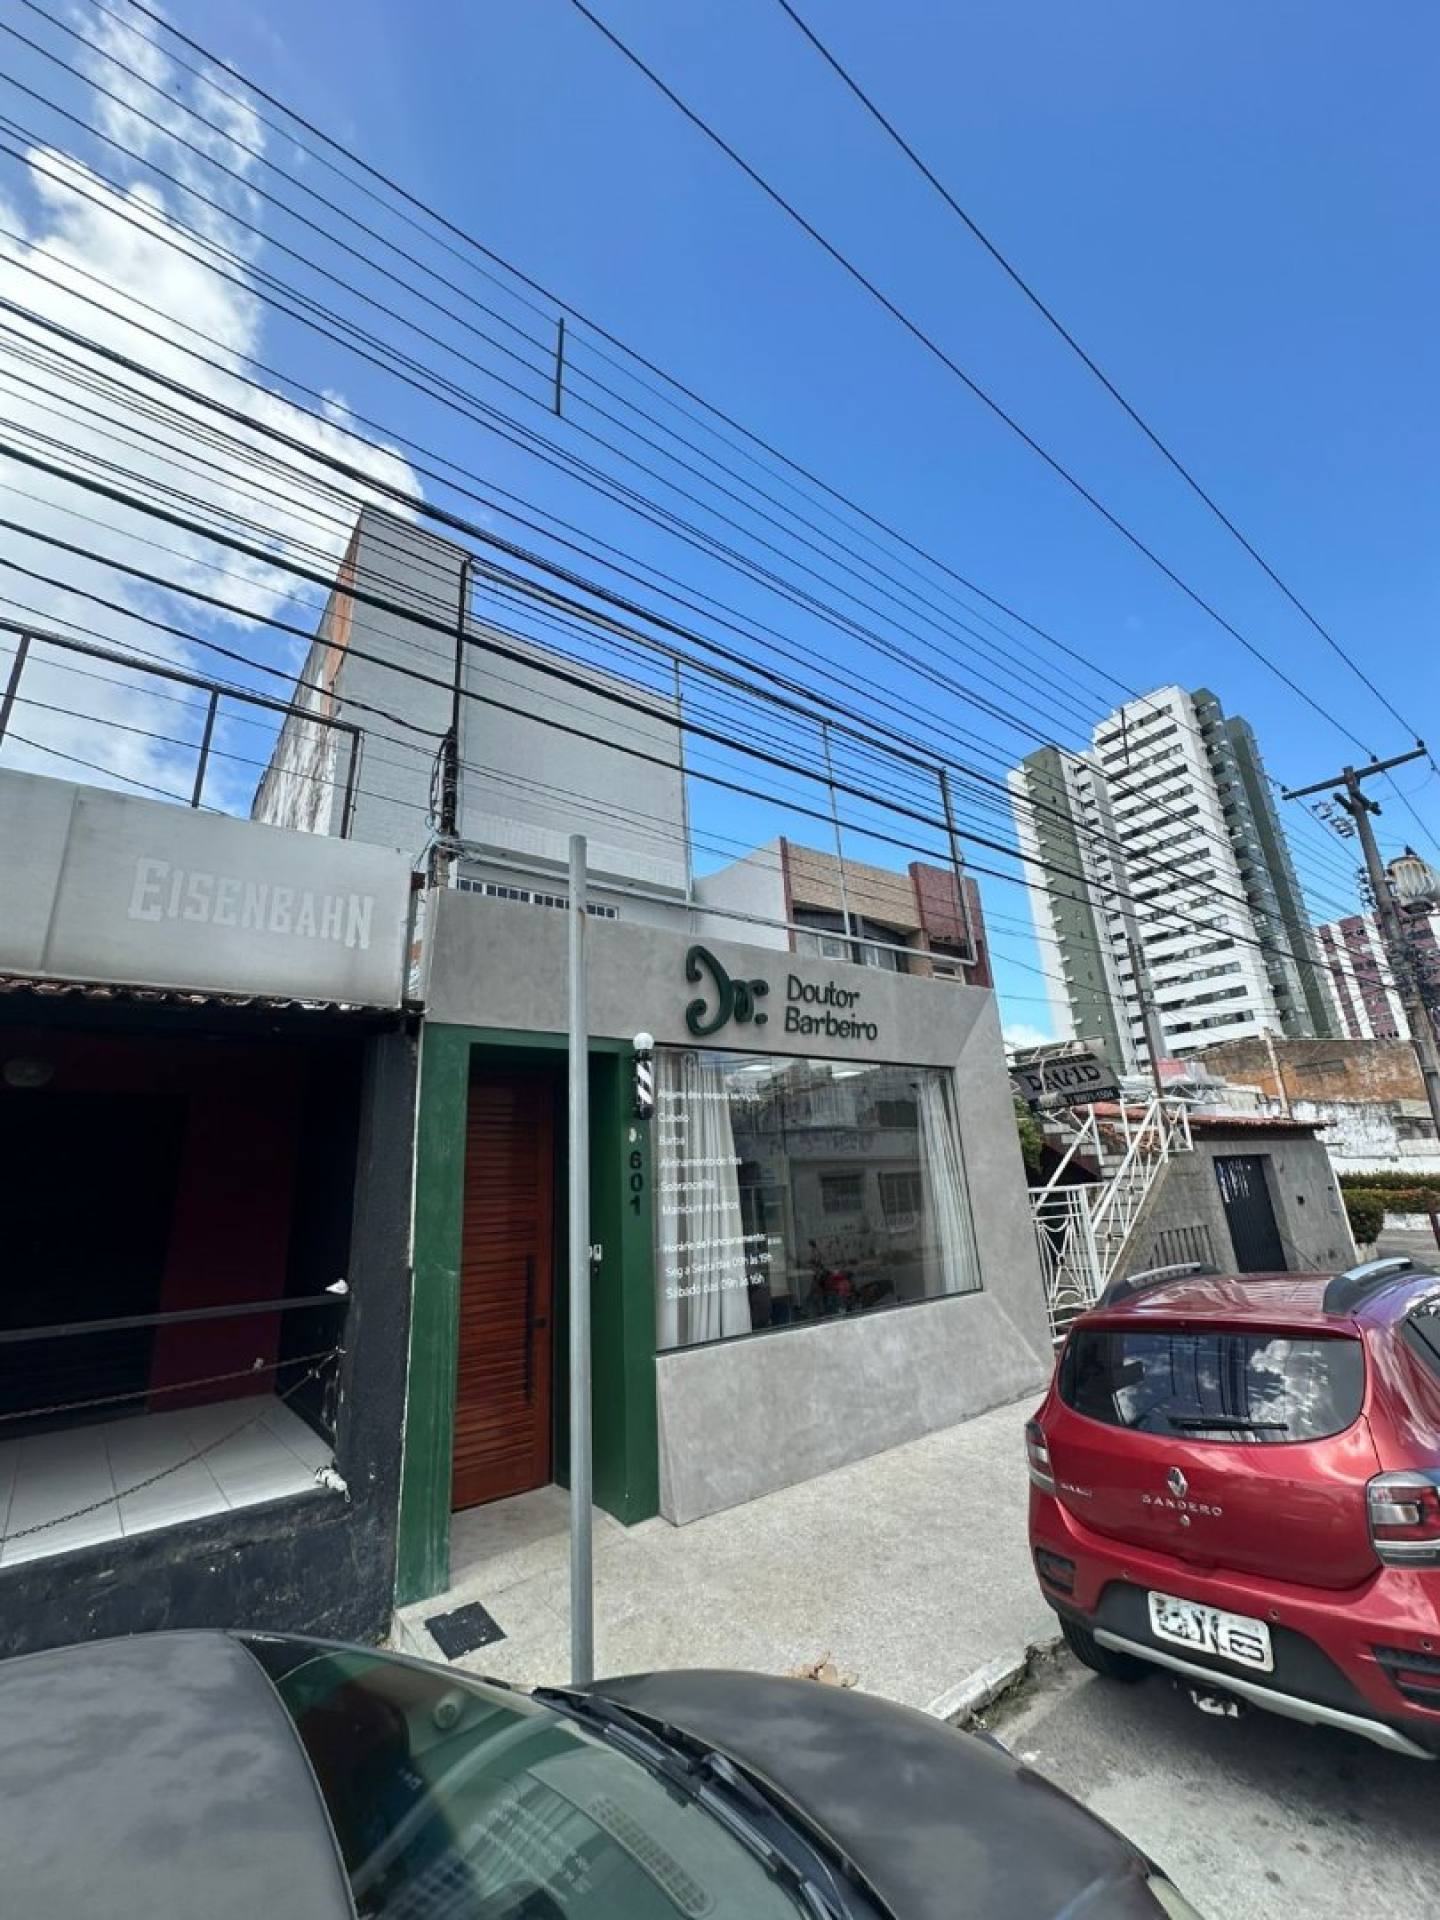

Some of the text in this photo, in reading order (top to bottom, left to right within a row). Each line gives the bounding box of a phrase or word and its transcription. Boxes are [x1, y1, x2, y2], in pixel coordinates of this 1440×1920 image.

[127, 855, 375, 951] EISENBAHN
[787, 973, 861, 1010] Doutor
[785, 1005, 878, 1041] Barbeiro
[630, 1151, 643, 1216] 601
[1141, 1494, 1222, 1517] SANDERO
